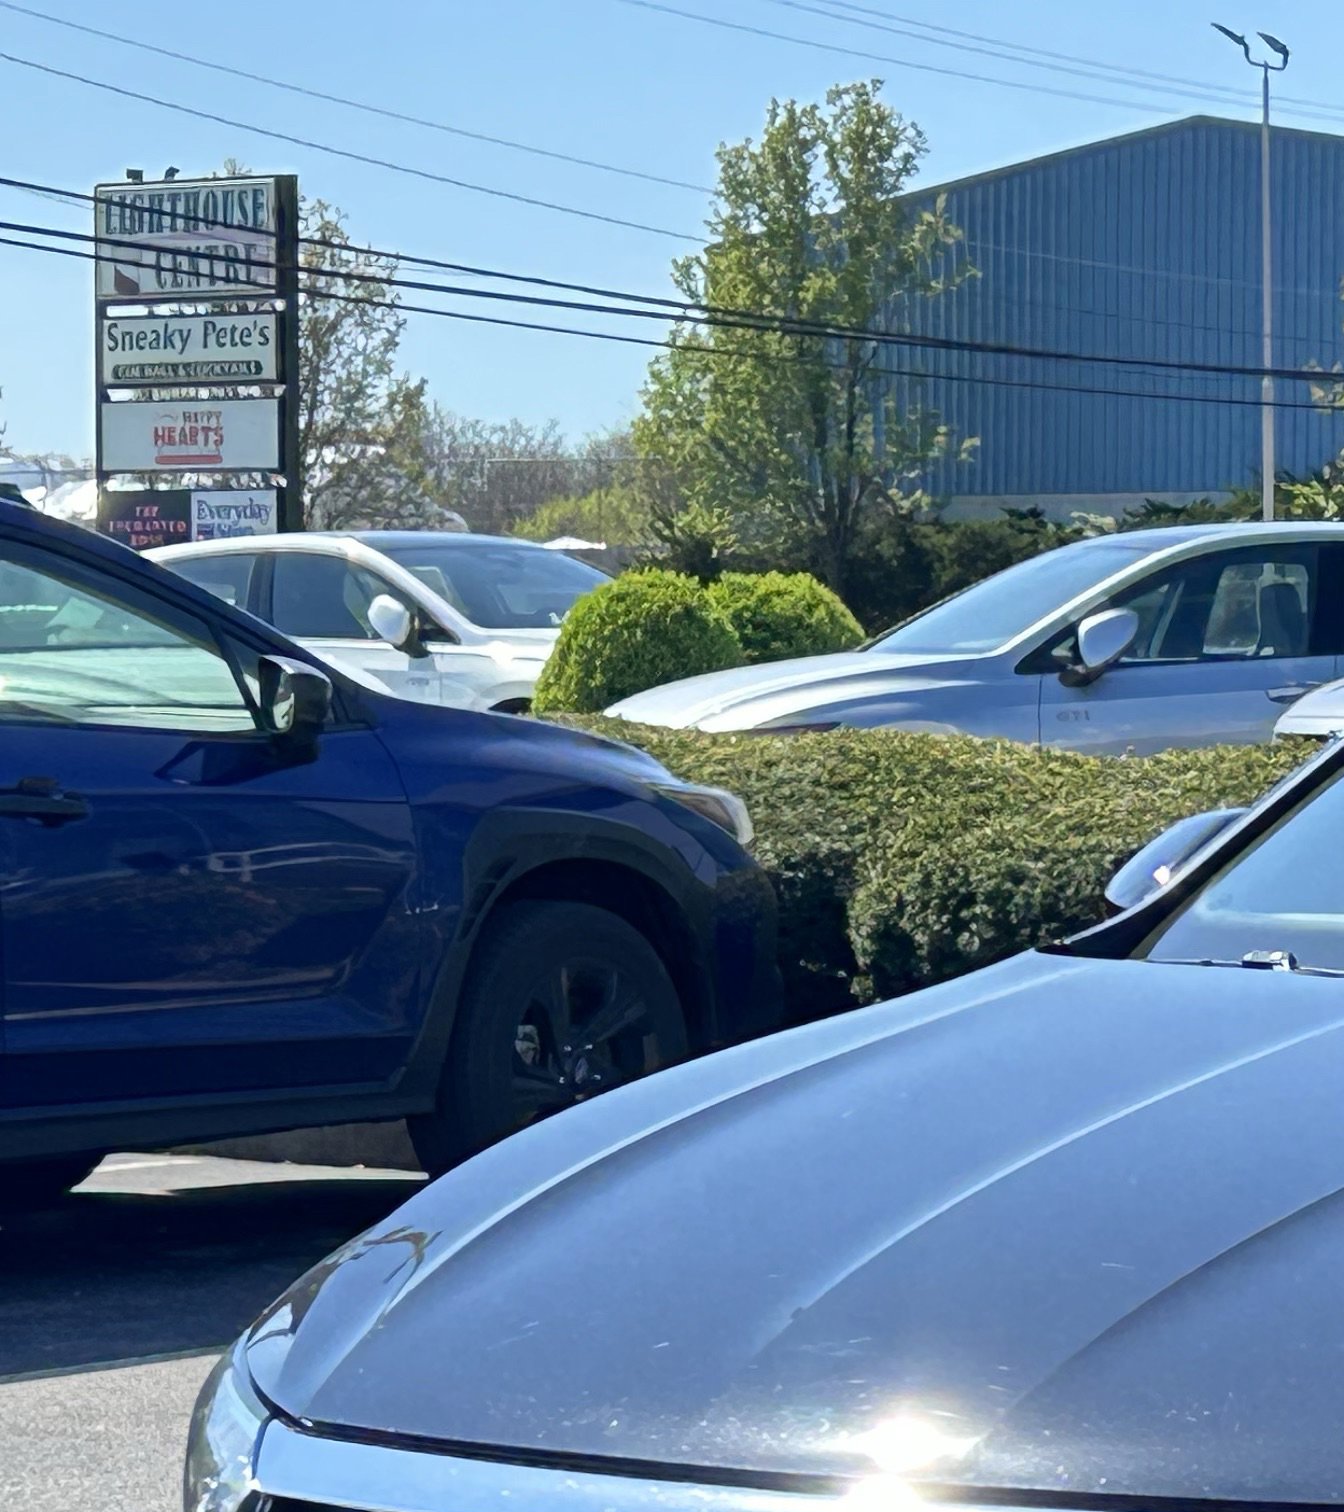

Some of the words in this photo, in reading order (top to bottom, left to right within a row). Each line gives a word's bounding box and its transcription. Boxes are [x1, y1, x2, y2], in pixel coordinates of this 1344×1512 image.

[105, 189, 265, 235] LIGHTHOUSE
[155, 243, 258, 288] CENTRE
[107, 322, 191, 355] Sneaky
[203, 320, 270, 349] Pete's
[154, 426, 224, 447] HEARTS
[196, 498, 272, 526] Everyday
